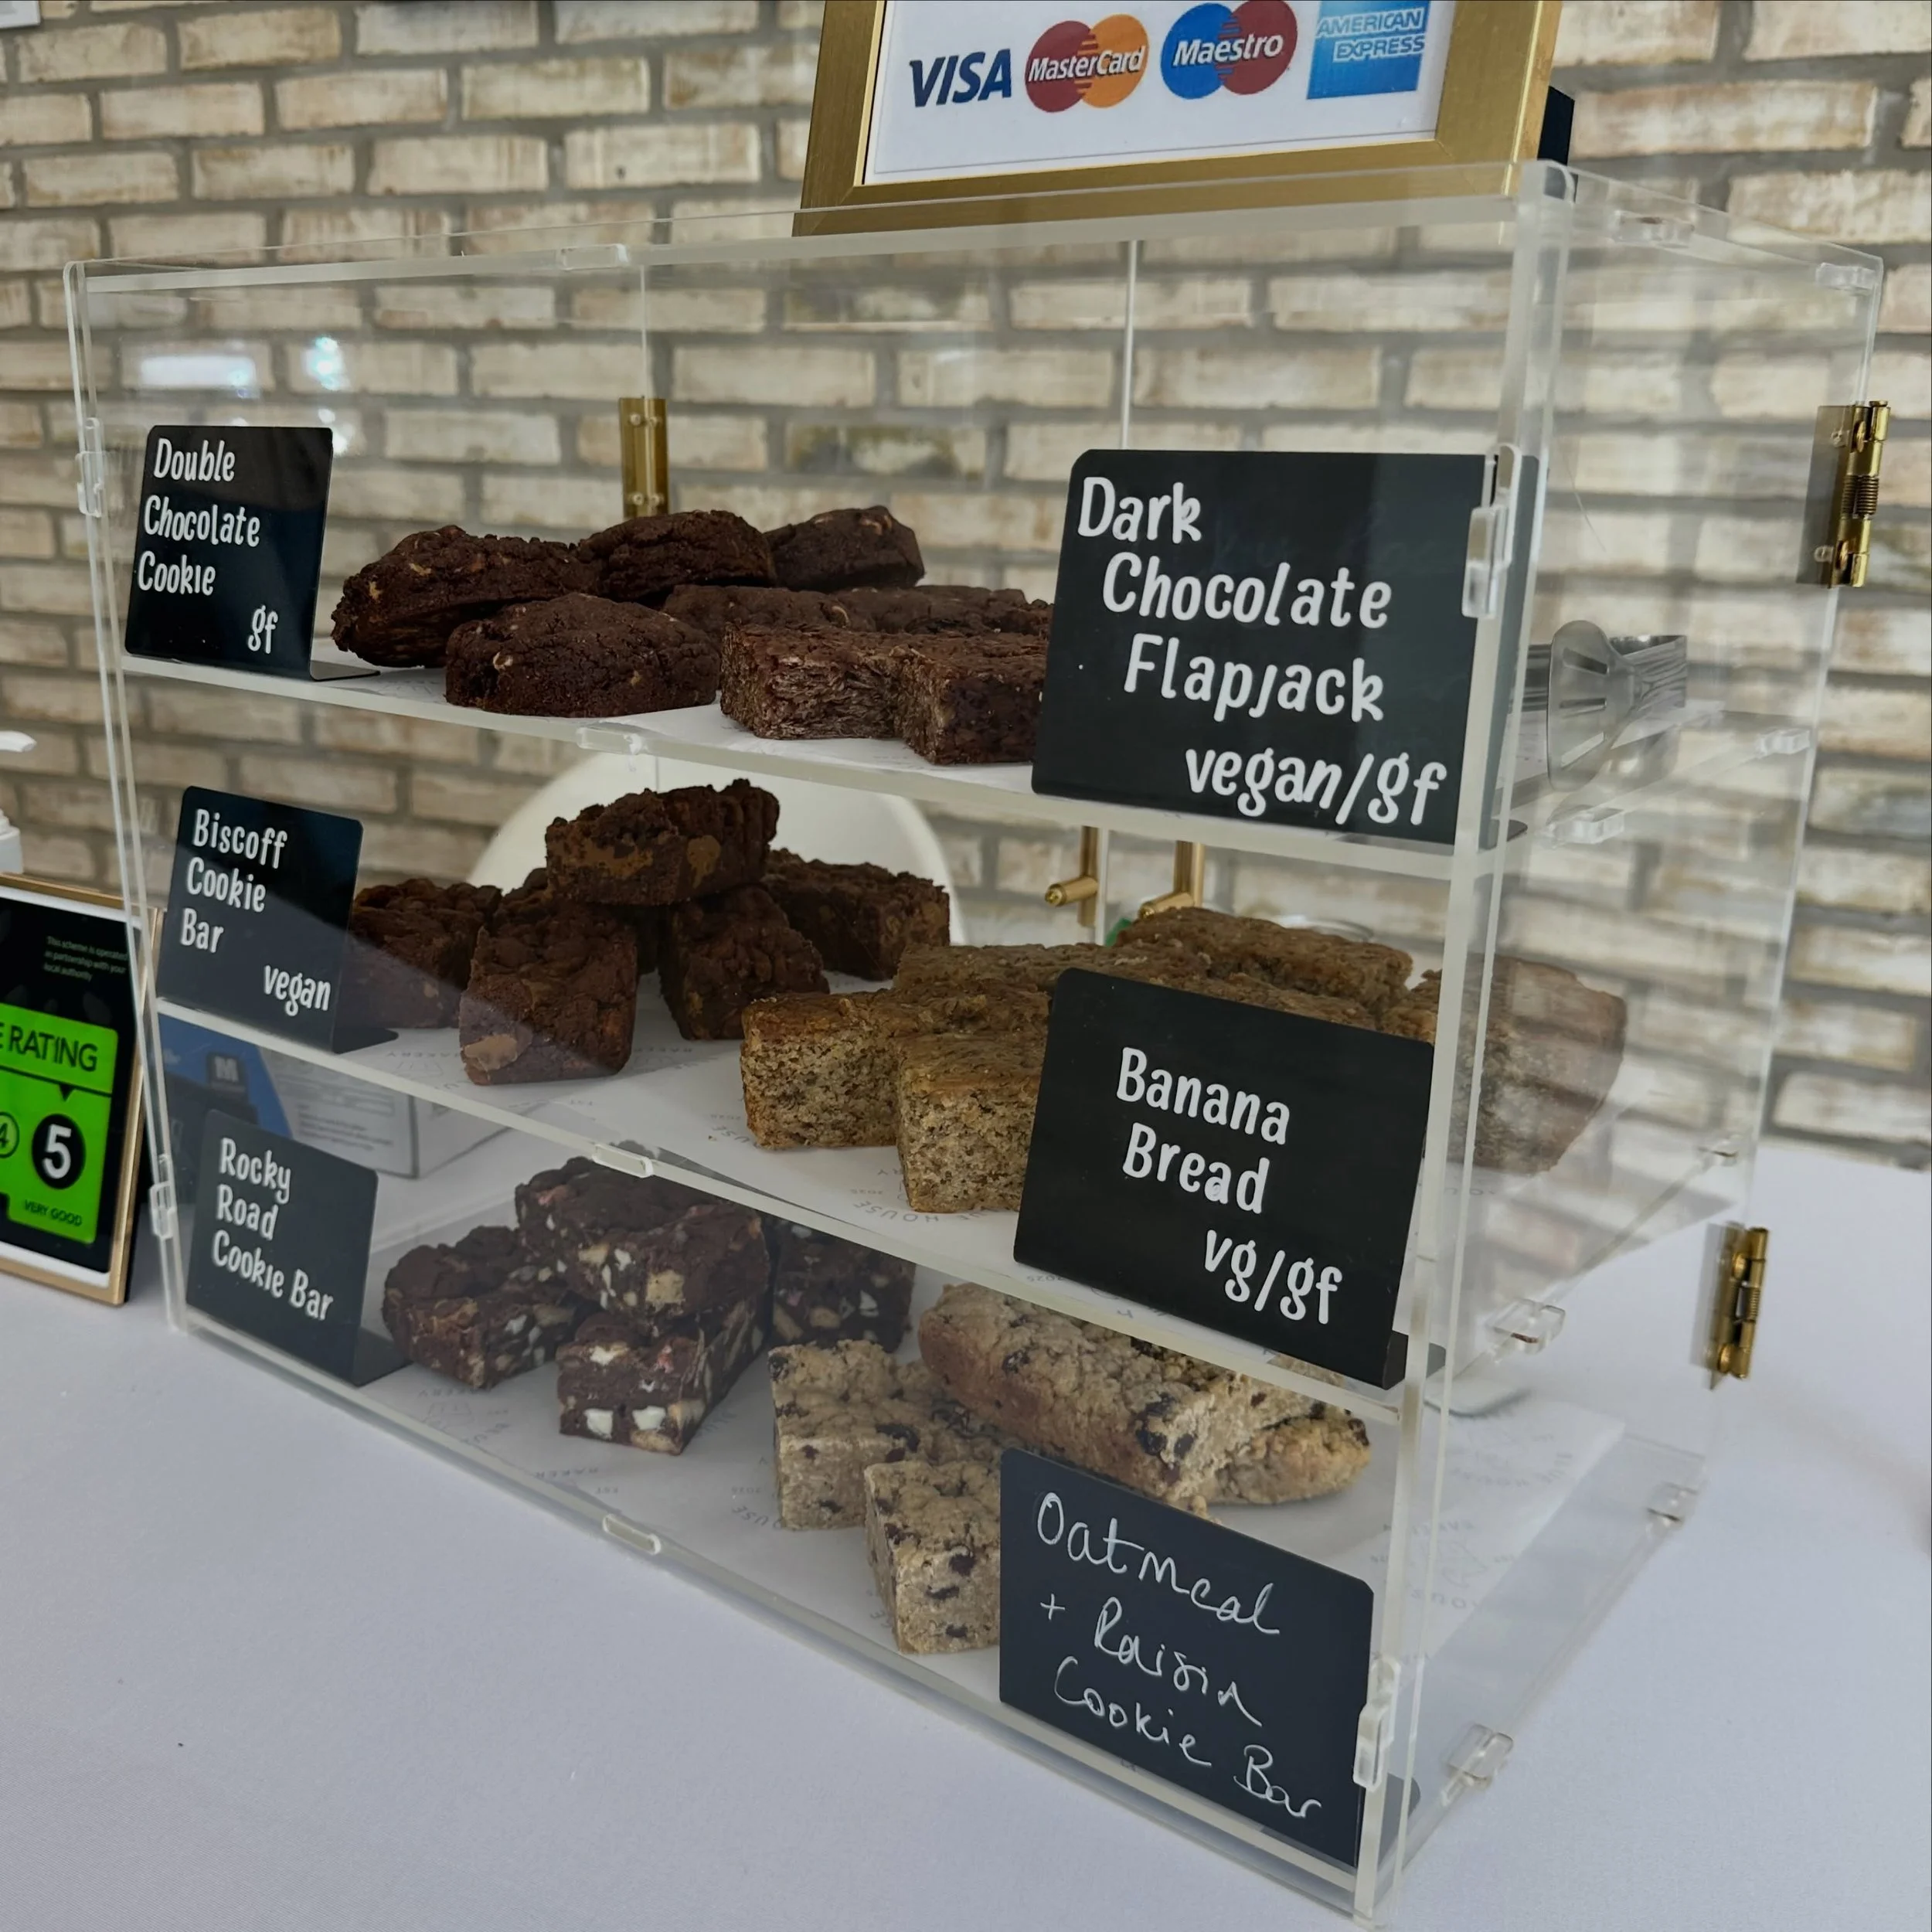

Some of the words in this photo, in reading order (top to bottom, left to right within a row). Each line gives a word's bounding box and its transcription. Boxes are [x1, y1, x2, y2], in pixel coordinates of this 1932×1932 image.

[1172, 33, 1284, 66] Maestro
[1315, 7, 1424, 38] AMERICAN
[1332, 32, 1427, 63] EXPRESS
[909, 49, 1012, 108] VISA
[1027, 46, 1144, 84] MasterCard
[154, 437, 235, 481] Double
[144, 495, 260, 547] Chocolate
[1077, 477, 1202, 543] Dark
[138, 550, 216, 596] Cookie
[1102, 552, 1393, 628] Chocolate
[247, 605, 279, 655] gf
[1124, 634, 1384, 722] Flapjack
[1185, 747, 1447, 825] vegan/gf
[191, 808, 288, 869] Biscoff
[186, 856, 266, 913] Cookie
[179, 907, 224, 954] Bar
[264, 964, 332, 1017] vegan
[9, 1026, 98, 1072] RATING
[1116, 1047, 1290, 1145] Banana
[42, 1124, 72, 1179] 5
[219, 1138, 291, 1204] Rocky
[1122, 1122, 1270, 1214] Bread
[24, 1199, 49, 1217] VERY
[50, 1207, 83, 1227] GOOD
[216, 1184, 278, 1240] Road
[852, 1200, 940, 1223] HOUSE
[212, 1230, 284, 1298] Cookie
[288, 1269, 333, 1321] Bar
[1205, 1230, 1342, 1325] vg/gf
[1037, 1492, 1281, 1635] Oatmeal
[1094, 1597, 1263, 1727] Raisin
[1054, 1655, 1213, 1767] Cookie
[1233, 1744, 1322, 1818] Bar
